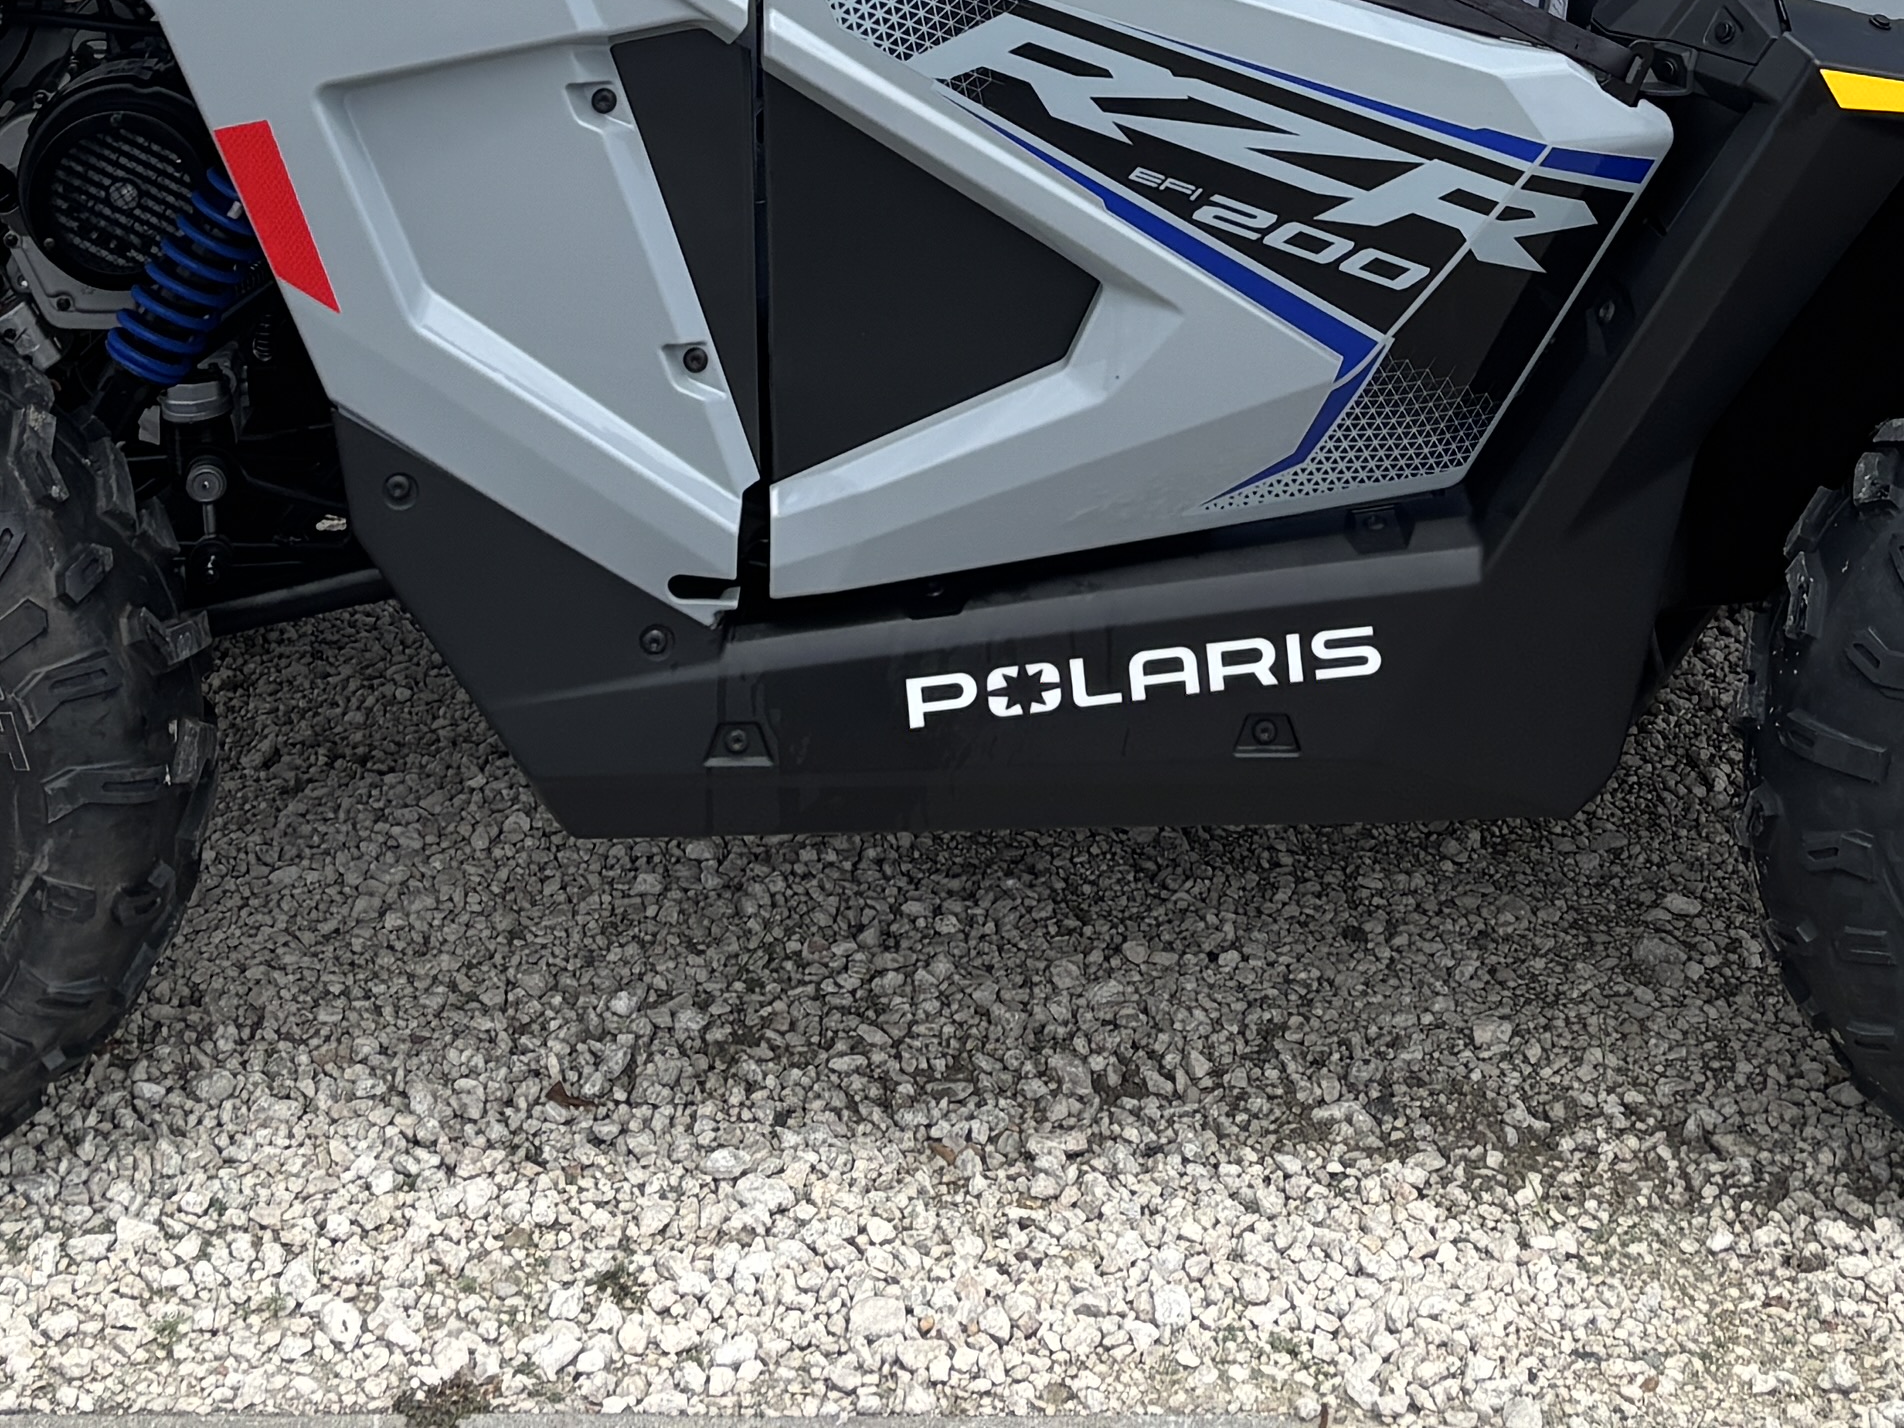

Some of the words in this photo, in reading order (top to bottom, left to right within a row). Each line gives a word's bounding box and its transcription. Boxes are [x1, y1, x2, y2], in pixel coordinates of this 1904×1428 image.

[907, 12, 1598, 274] RZR
[1128, 166, 1203, 202] EFI
[1192, 193, 1432, 291] 200
[905, 626, 1382, 729] POLARIS
